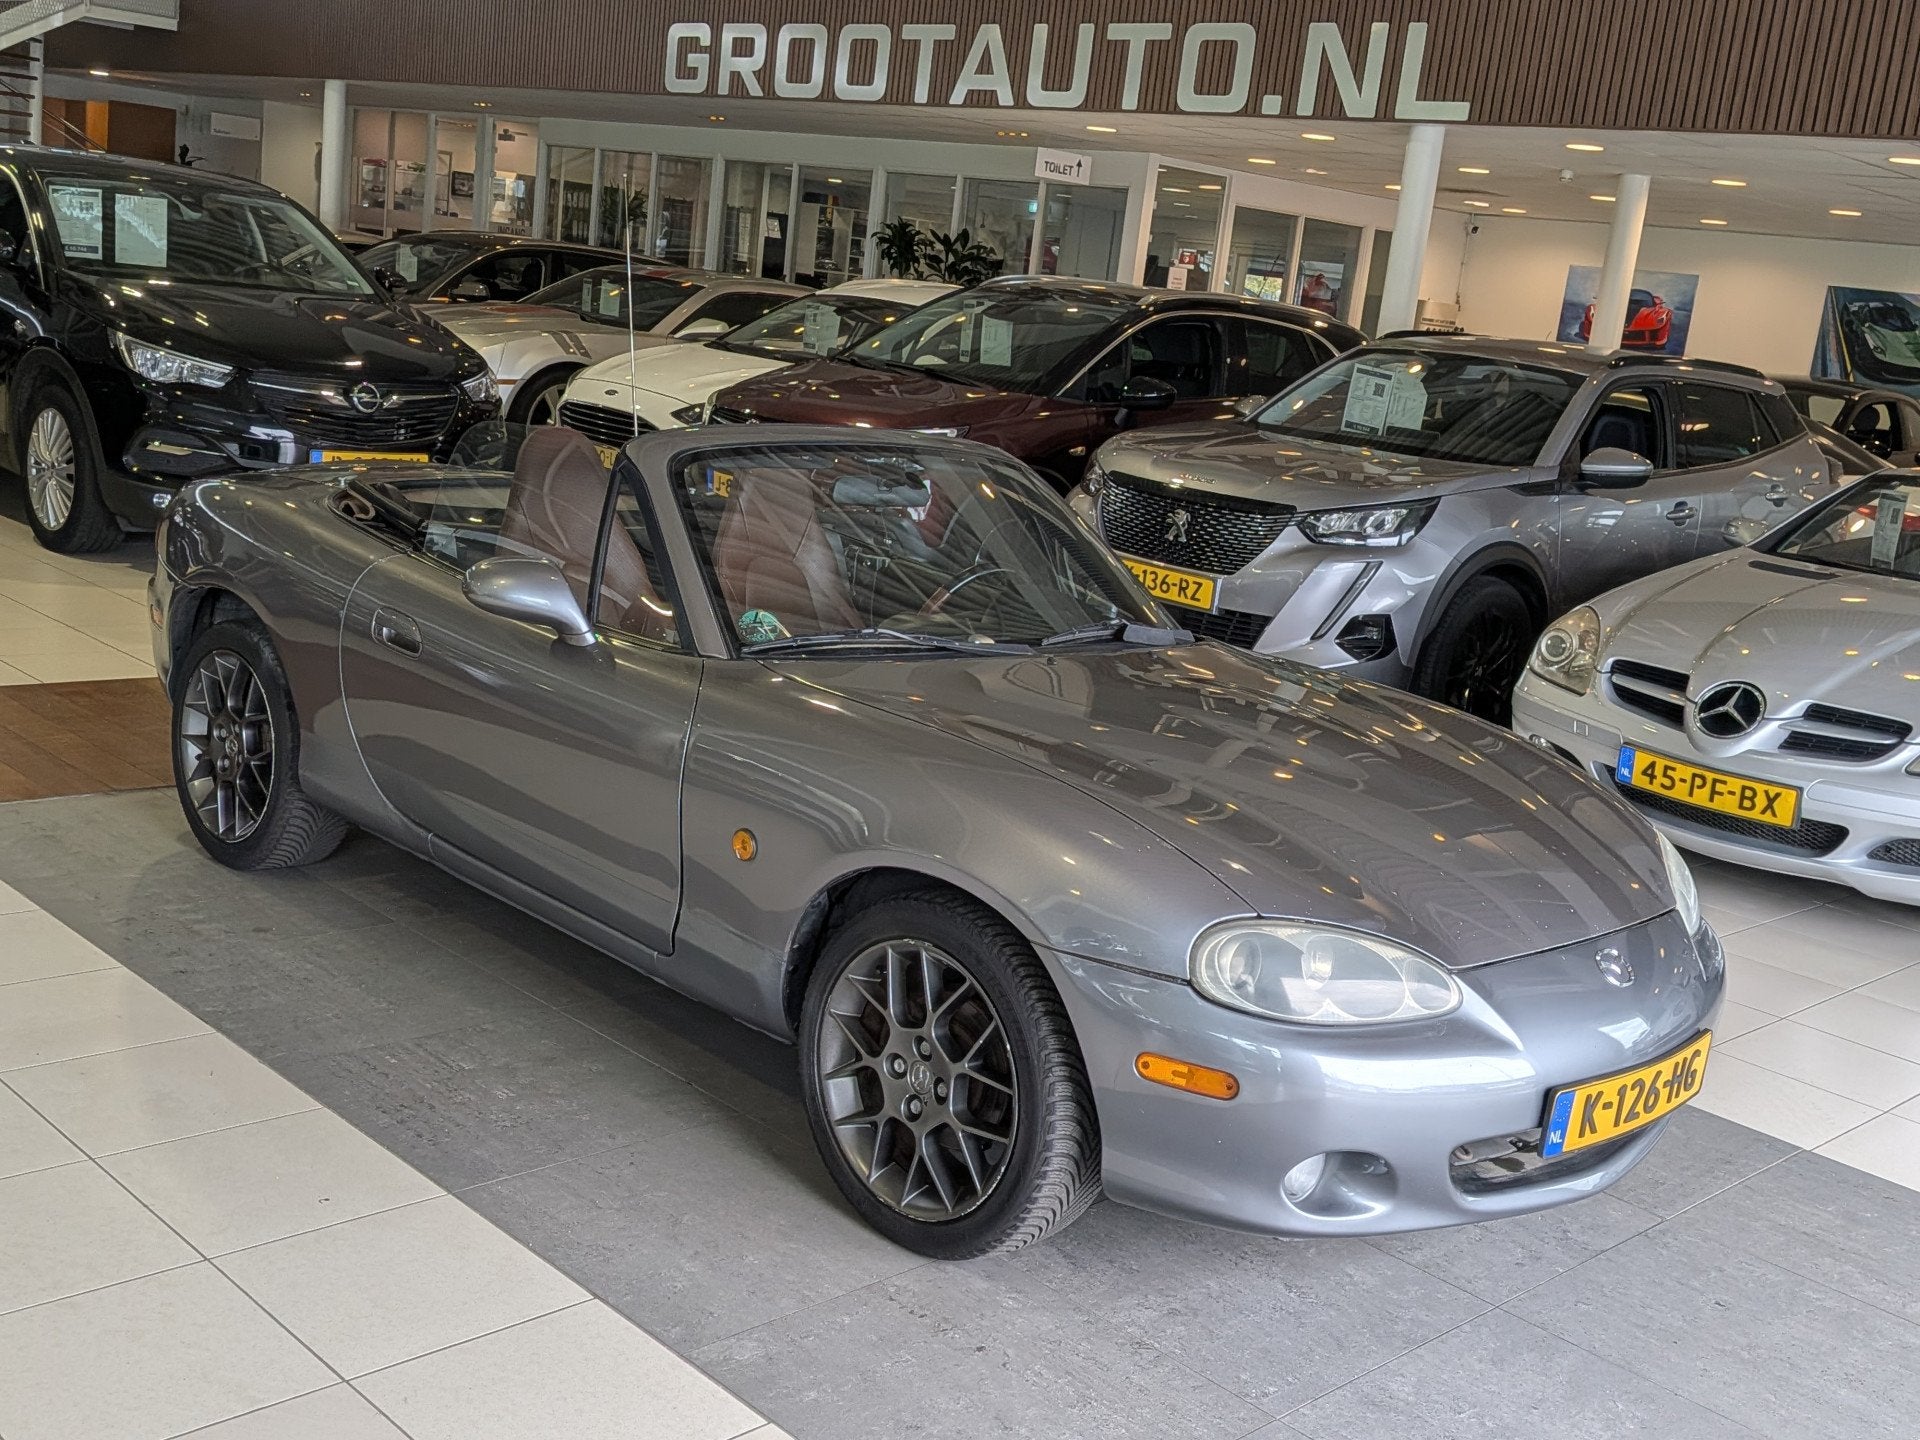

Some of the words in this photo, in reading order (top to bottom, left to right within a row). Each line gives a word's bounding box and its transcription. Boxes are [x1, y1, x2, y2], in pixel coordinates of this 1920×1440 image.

[664, 22, 1470, 121] GROOTAUTO.NL
[1044, 160, 1075, 176] TOILET
[1127, 565, 1203, 603] -136-RZ
[1620, 766, 1632, 778] NL
[1641, 760, 1782, 818] 45-PF-BX
[1578, 1048, 1702, 1139] K-126-HG
[1548, 1129, 1563, 1145] NL
